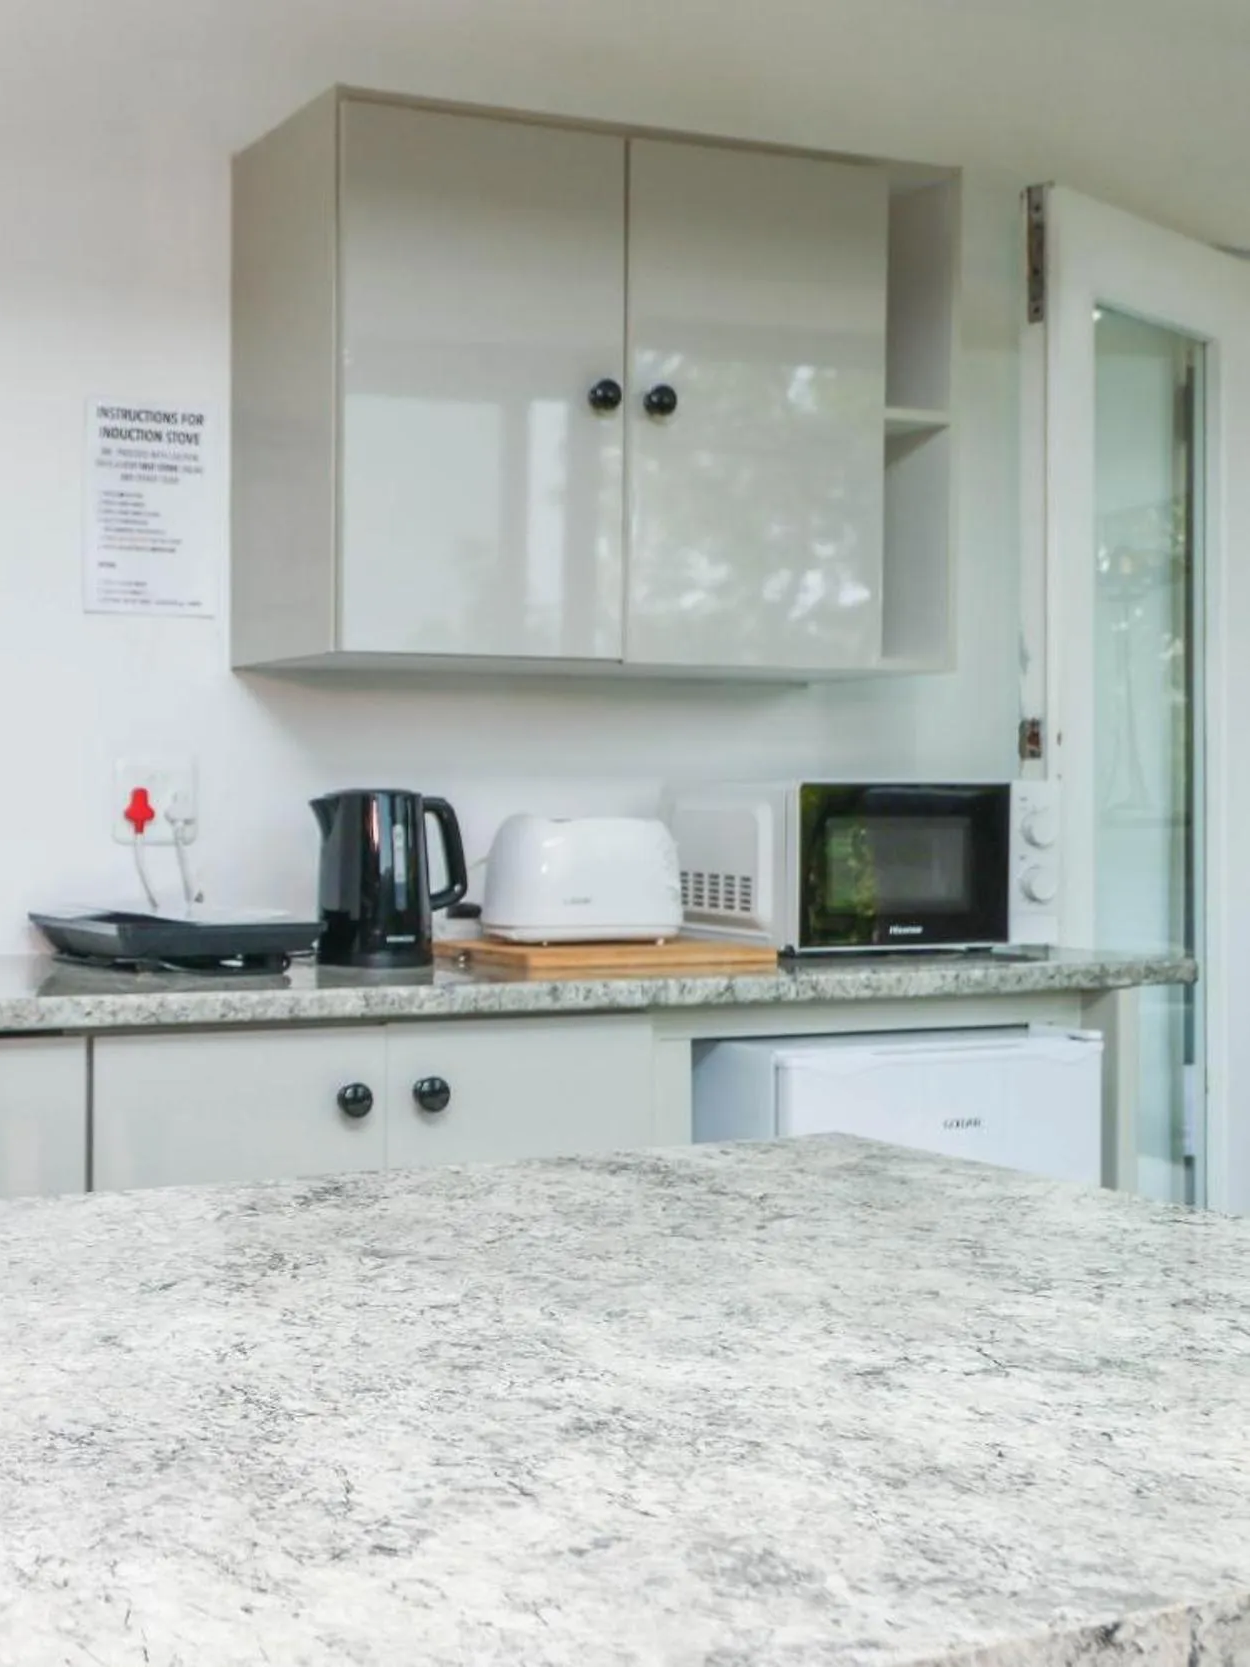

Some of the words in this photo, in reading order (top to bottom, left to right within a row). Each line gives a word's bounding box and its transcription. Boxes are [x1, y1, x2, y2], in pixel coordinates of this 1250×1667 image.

[96, 406, 179, 425] INSTRUCTIONS
[181, 413, 205, 426] FOR
[99, 426, 163, 443] INDUCTION
[166, 431, 199, 446] STOVE
